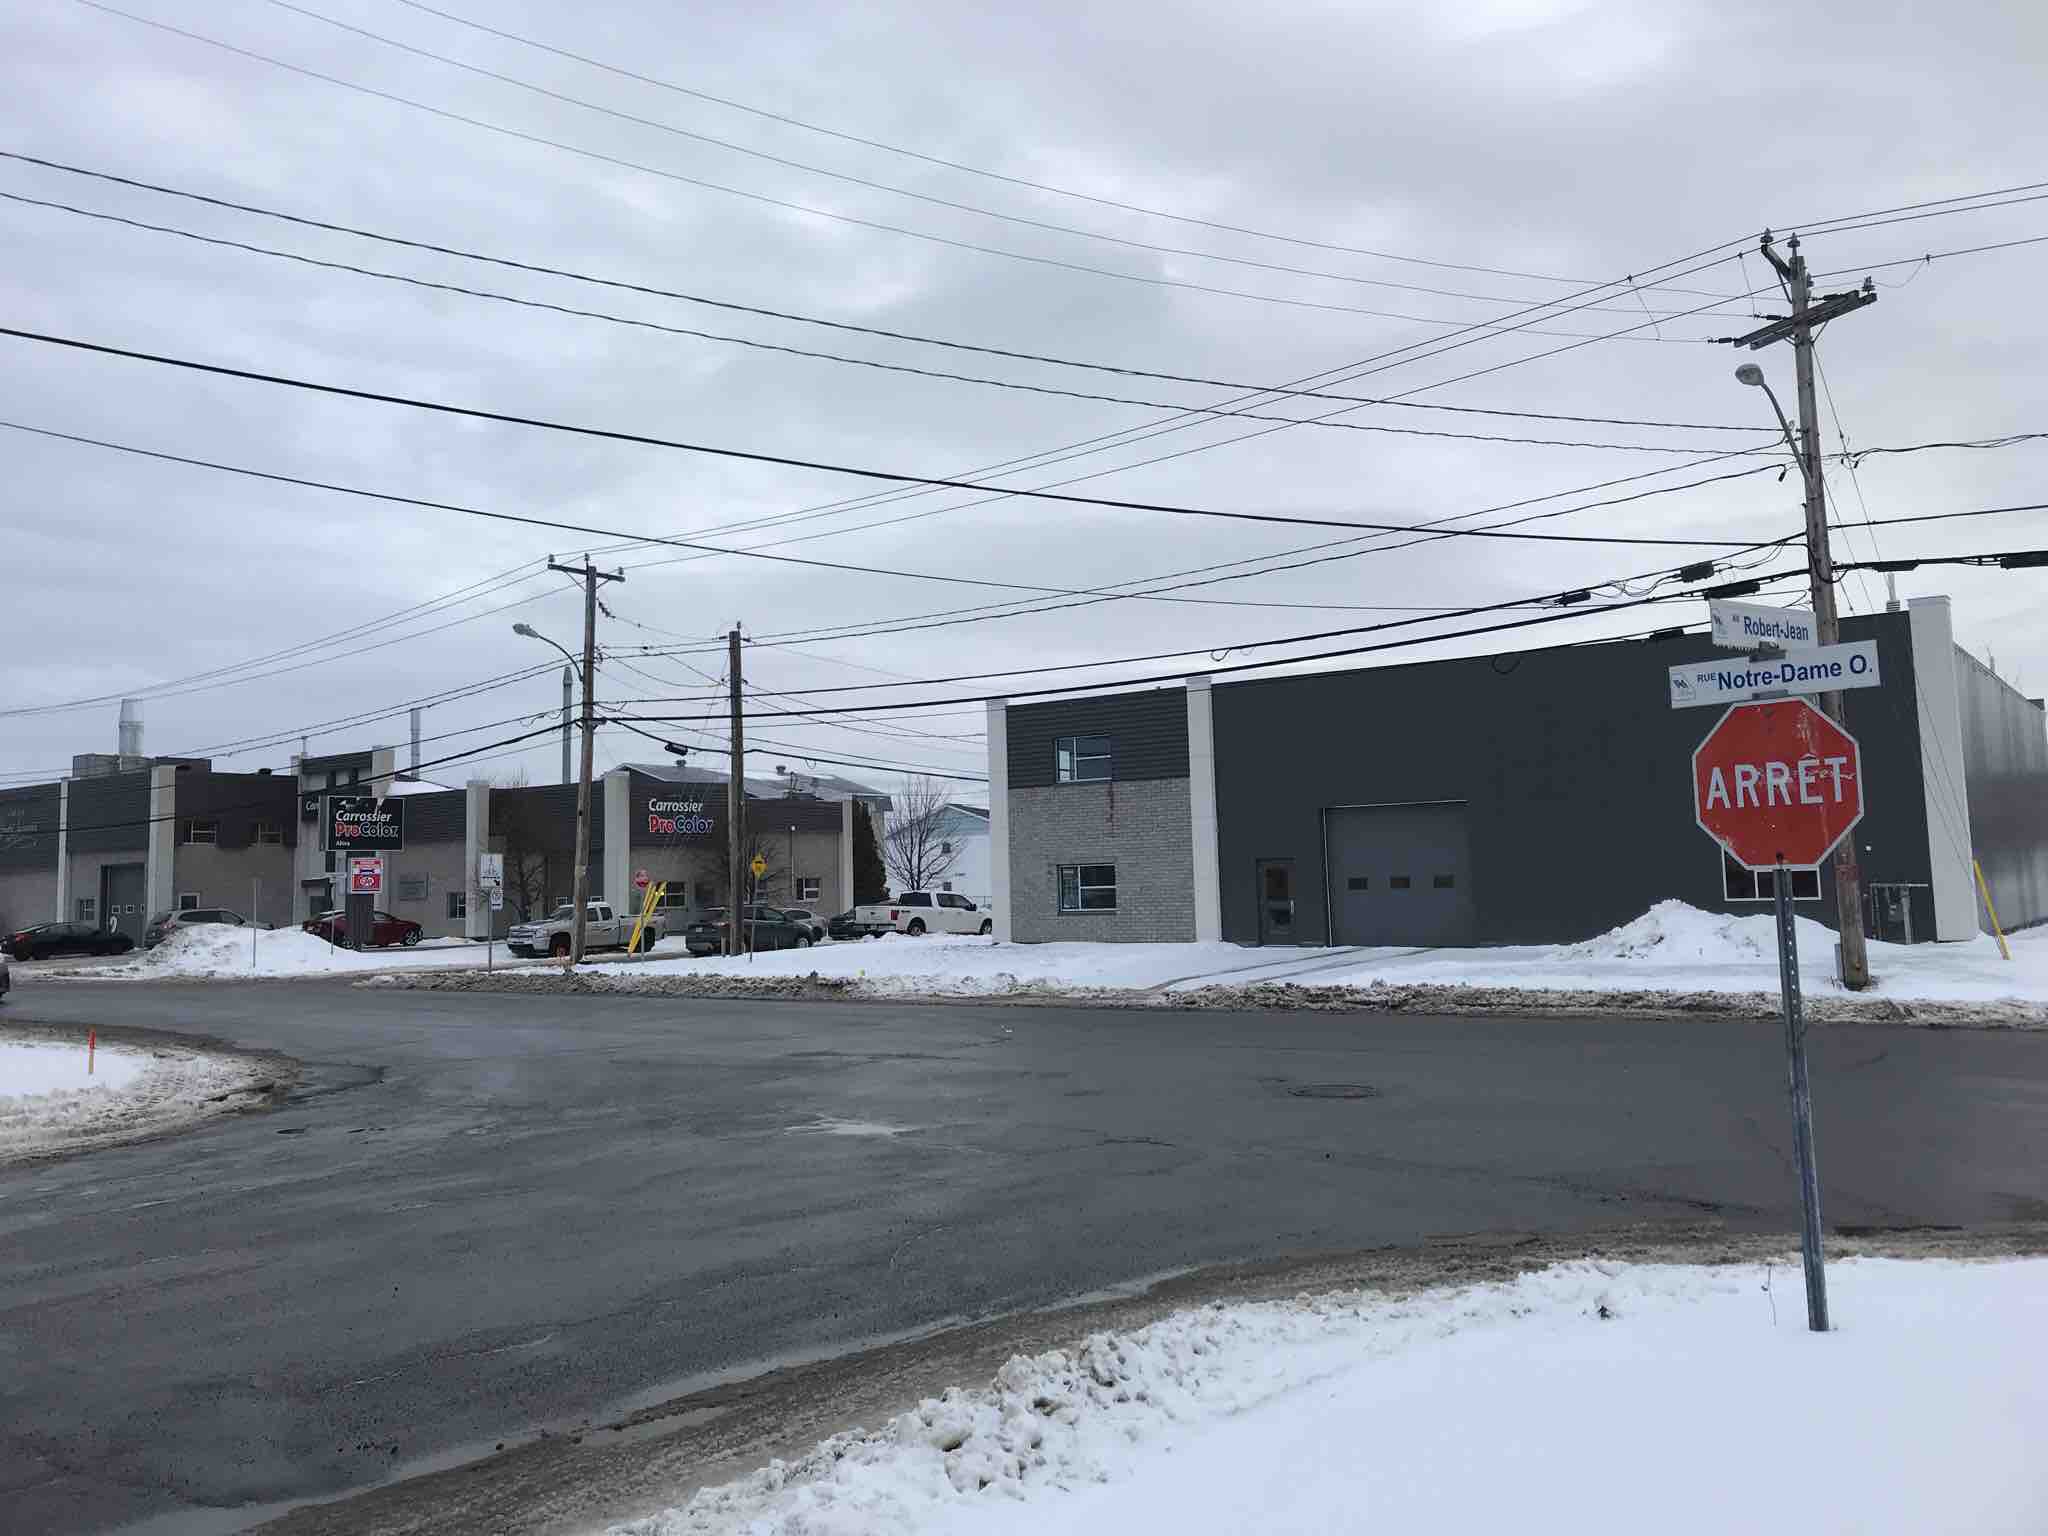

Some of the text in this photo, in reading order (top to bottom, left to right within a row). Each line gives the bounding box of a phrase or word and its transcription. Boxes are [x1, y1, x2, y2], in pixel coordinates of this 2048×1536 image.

[1743, 615, 1809, 640] Robert-Jean
[1697, 654, 1873, 690] RUE Notre-Dame O.
[1705, 753, 1848, 810] ARRÊT
[647, 798, 703, 812] Carrossier
[335, 810, 393, 822] Carrossier
[648, 814, 714, 833] ProColor
[335, 821, 399, 837] ProColor
